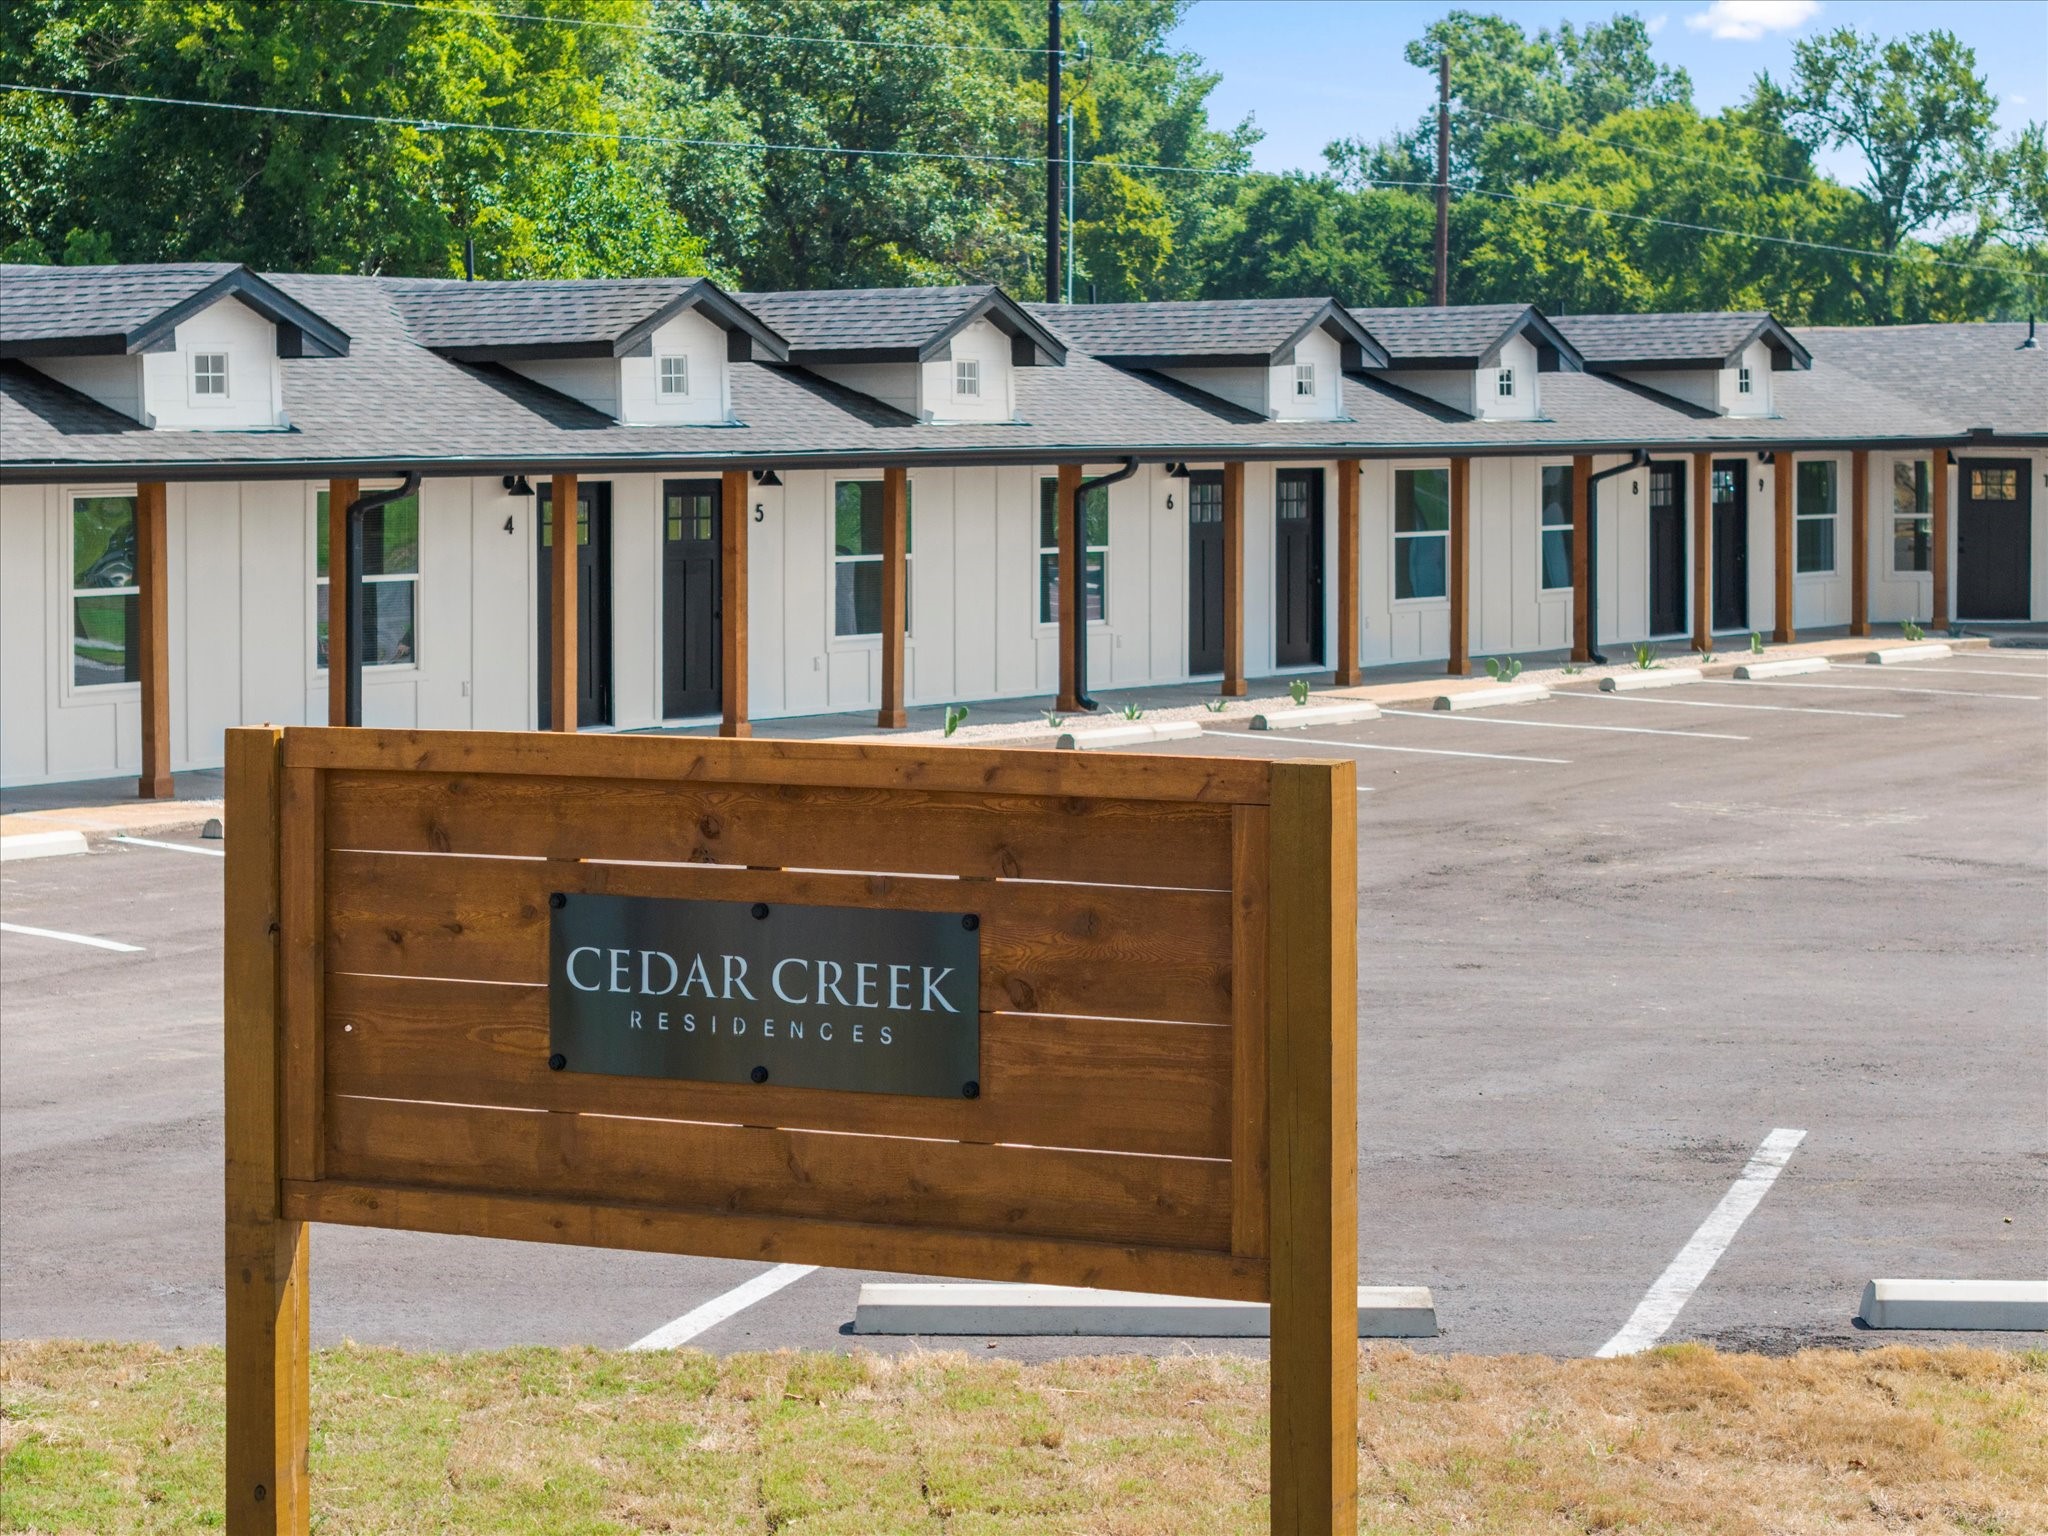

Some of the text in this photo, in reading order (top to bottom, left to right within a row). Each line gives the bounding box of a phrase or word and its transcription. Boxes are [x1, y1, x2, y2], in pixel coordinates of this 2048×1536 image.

[1632, 480, 1639, 495] 8
[1166, 493, 1174, 510] 6
[754, 503, 764, 523] 5
[503, 514, 515, 535] 4
[566, 946, 960, 1013] CEDAR CREEK
[630, 1010, 893, 1045] RESIDENCES
